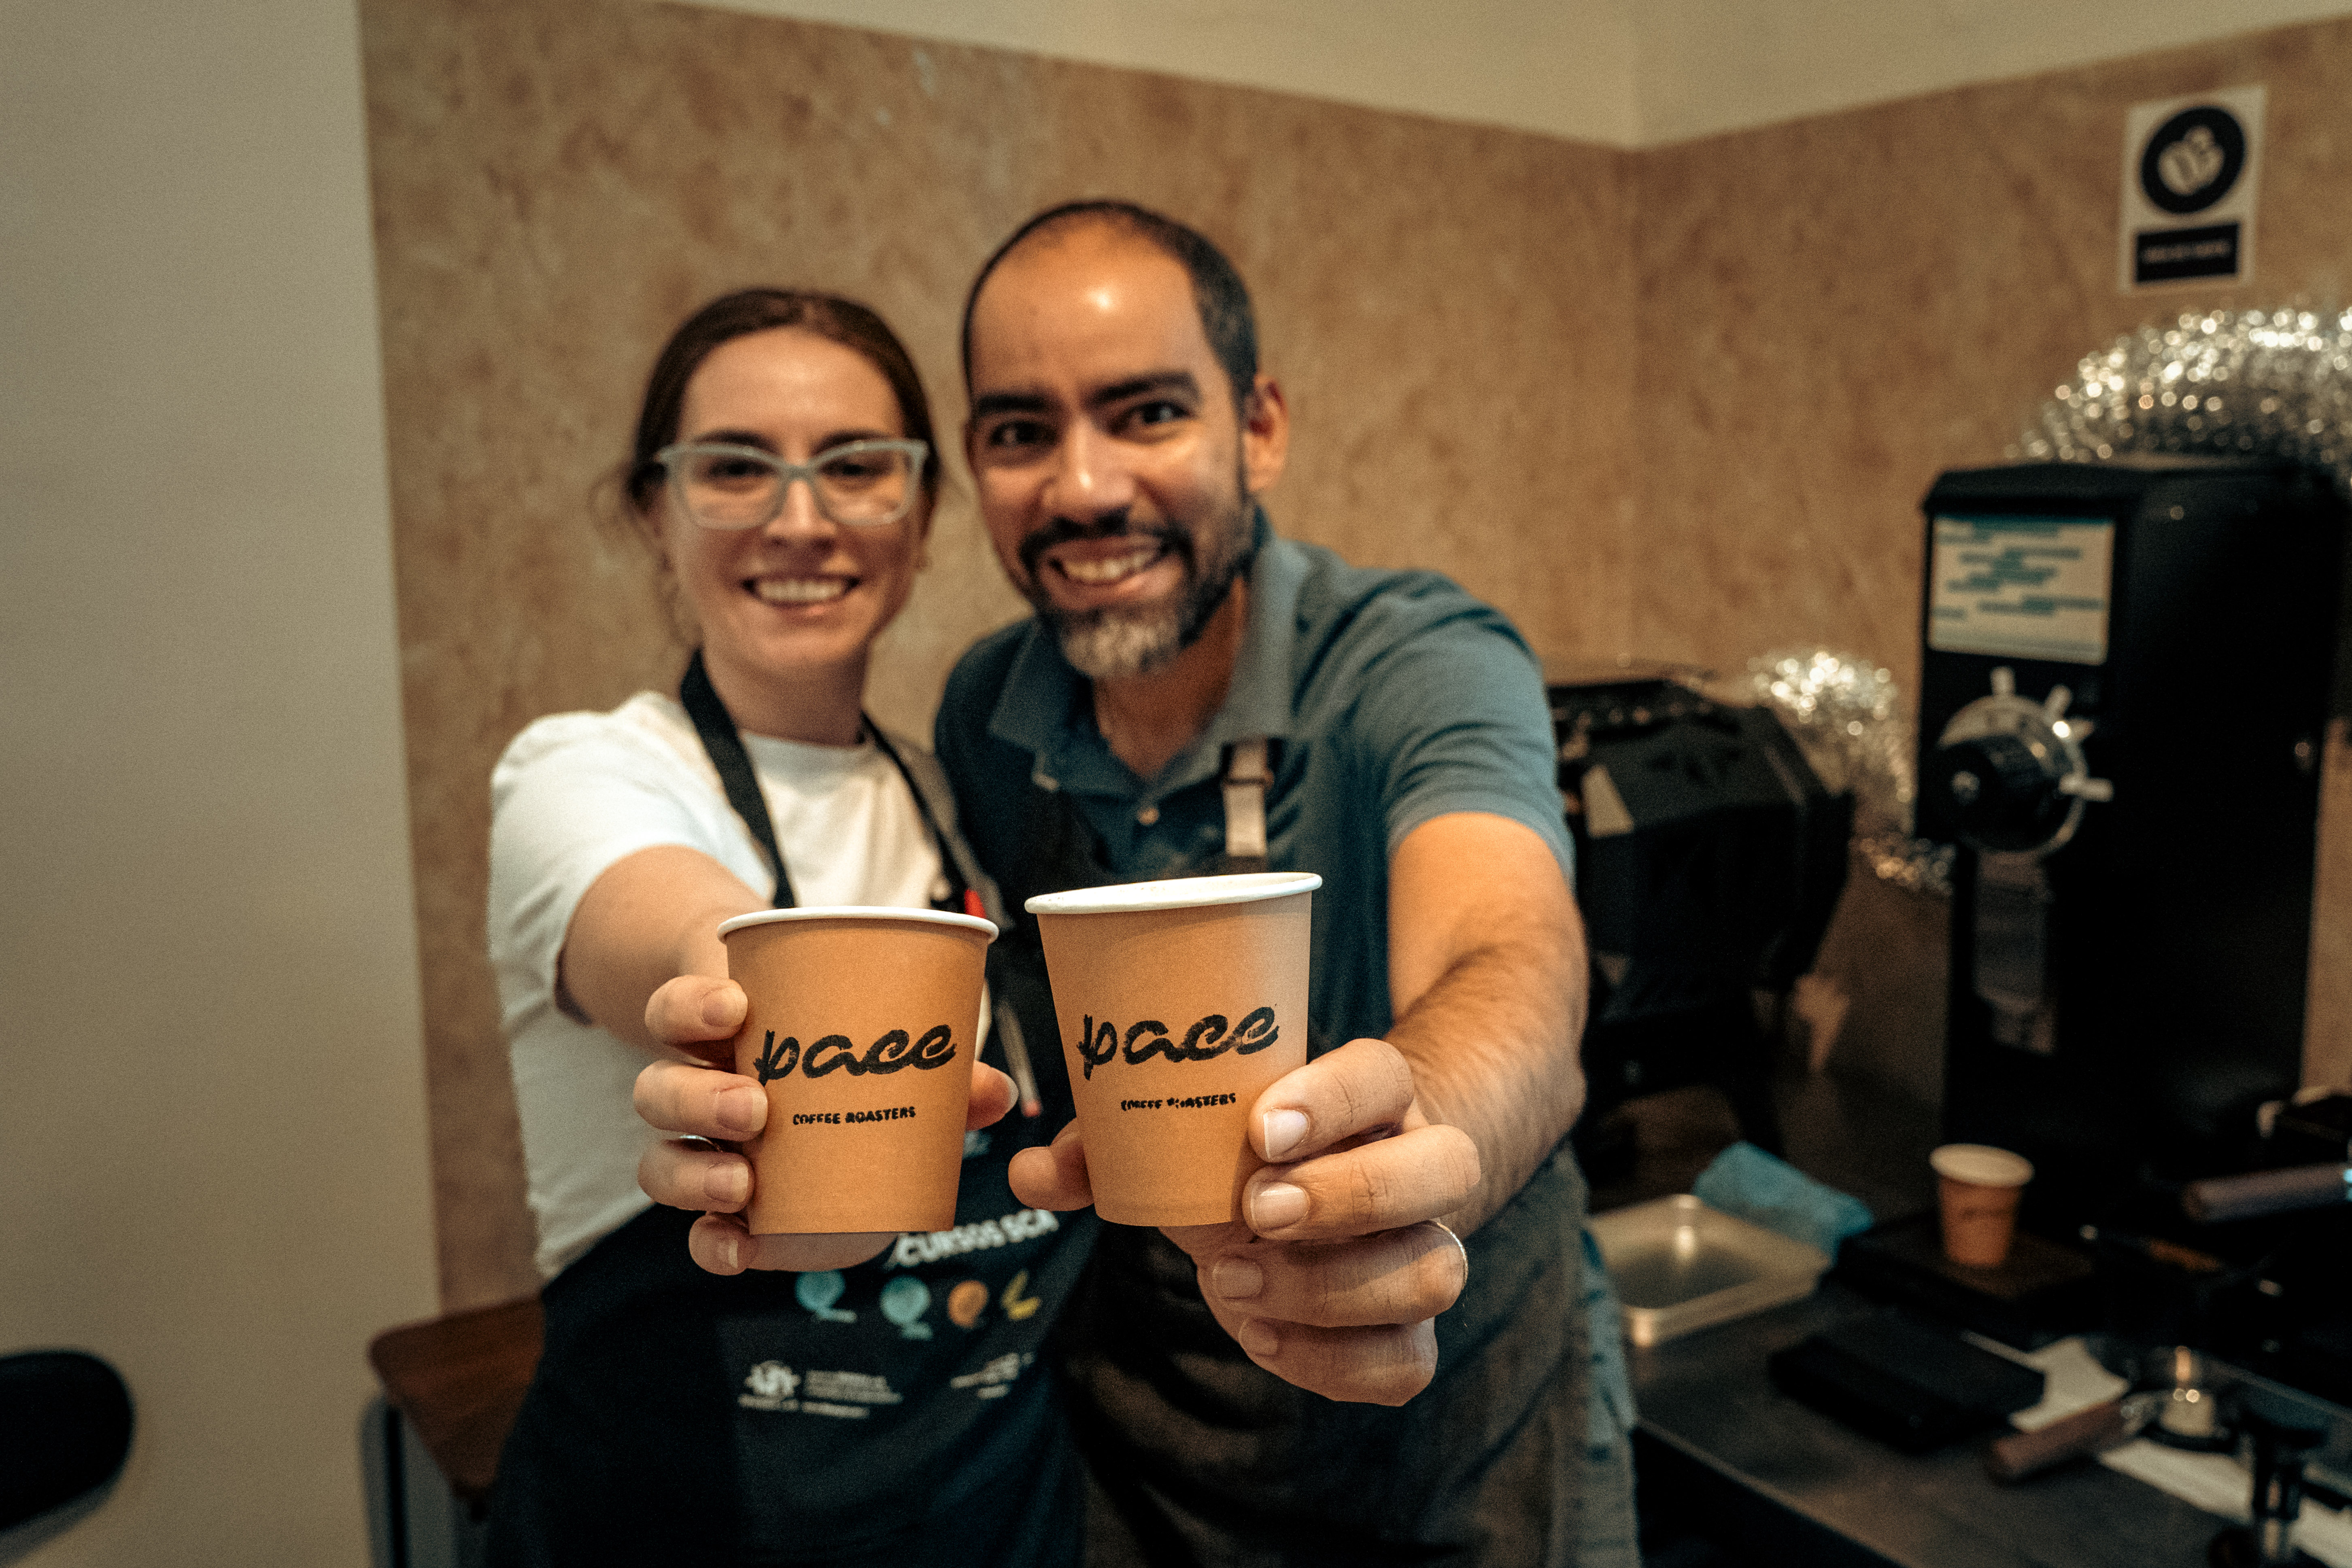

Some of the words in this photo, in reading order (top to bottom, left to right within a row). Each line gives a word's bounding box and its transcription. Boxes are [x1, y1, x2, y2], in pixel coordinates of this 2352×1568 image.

[753, 1024, 957, 1087] pace
[1076, 1006, 1279, 1080] pace
[792, 1113, 841, 1125] COFFEE
[845, 1105, 916, 1123] ROASTERS
